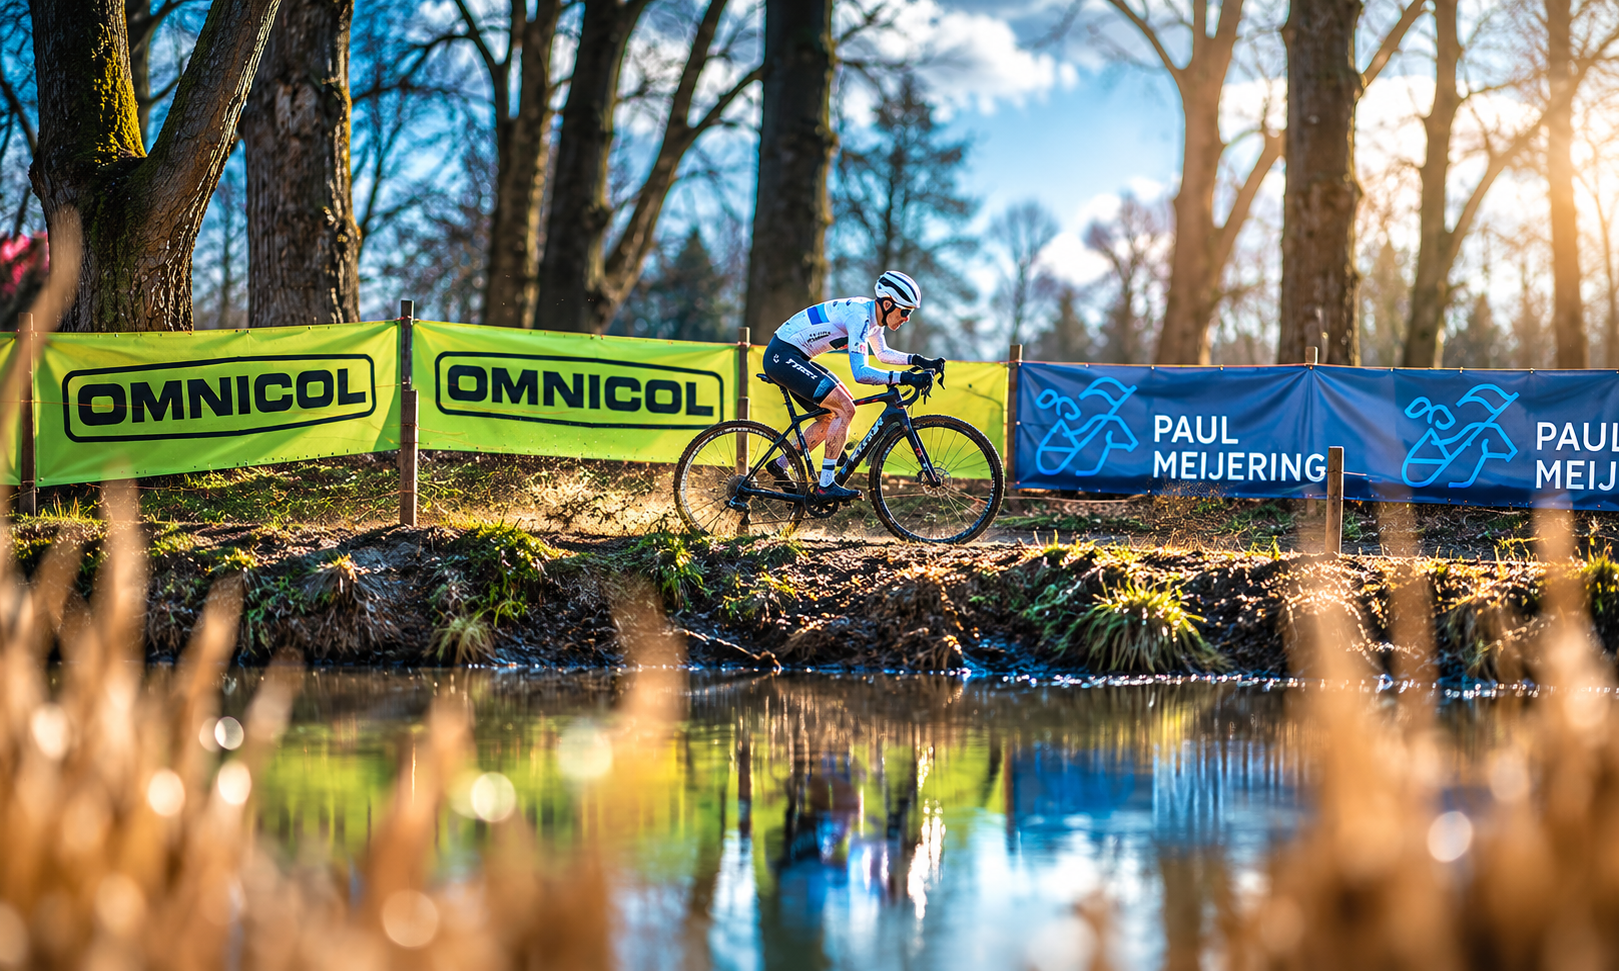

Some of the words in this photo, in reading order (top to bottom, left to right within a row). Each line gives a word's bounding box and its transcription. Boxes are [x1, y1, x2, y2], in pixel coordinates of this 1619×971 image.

[77, 368, 367, 427] OMNICOL
[447, 364, 714, 417] OMNICOL
[1153, 414, 1239, 445] PAUL
[1152, 450, 1327, 483] MEIJERING
